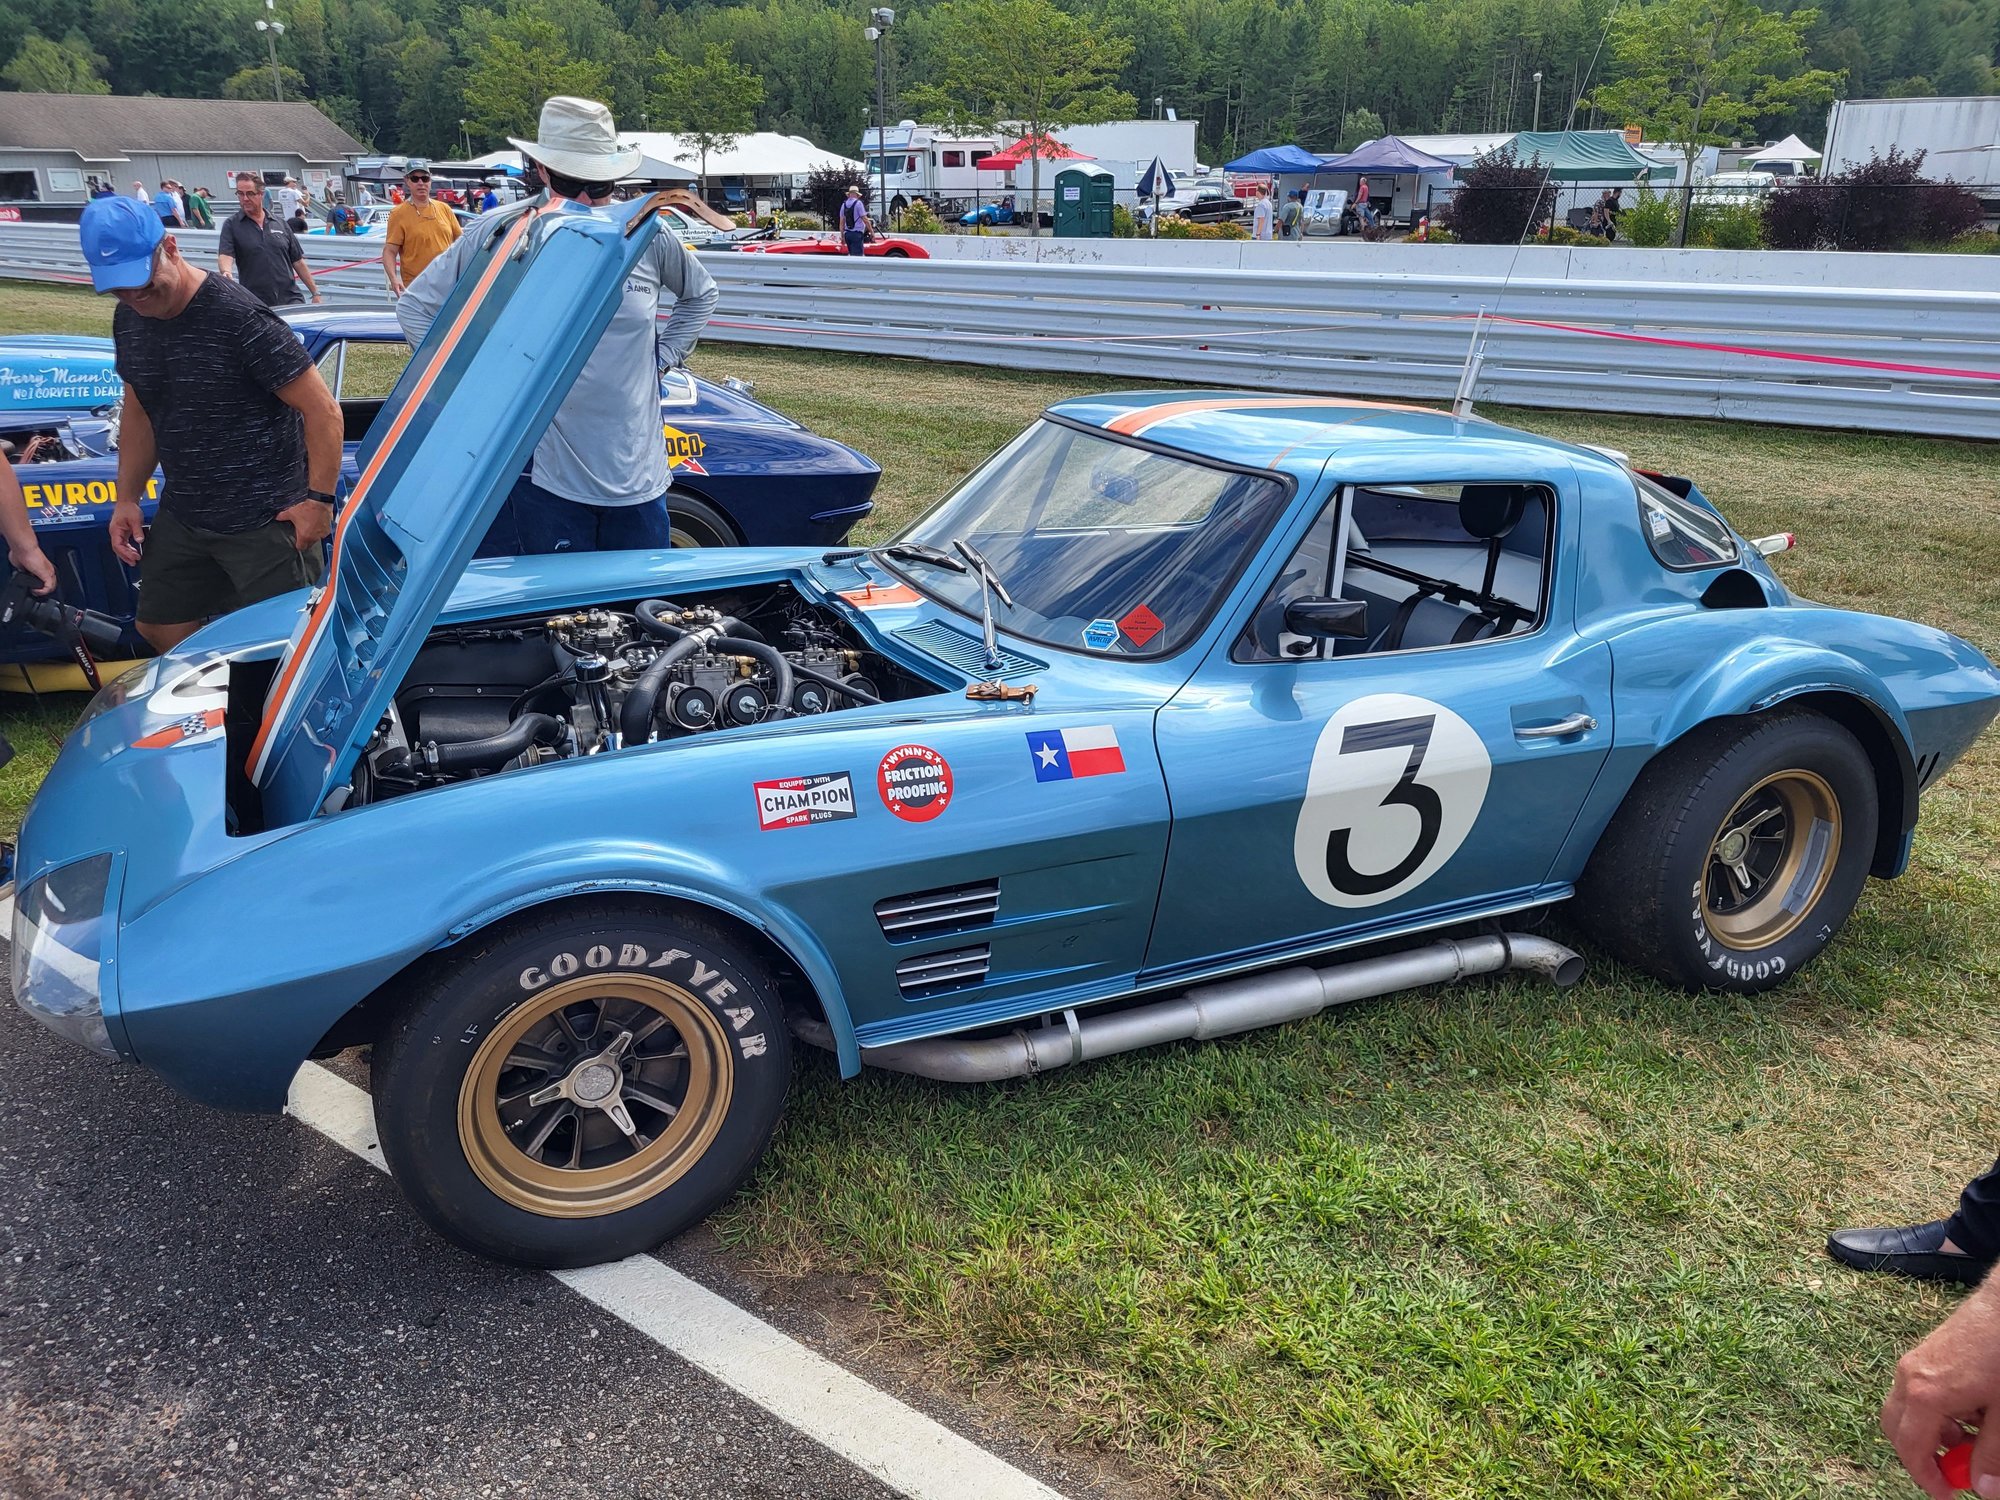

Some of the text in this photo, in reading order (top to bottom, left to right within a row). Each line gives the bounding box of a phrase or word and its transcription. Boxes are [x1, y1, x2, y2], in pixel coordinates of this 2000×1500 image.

[0, 367, 124, 387] Harry Mann CH
[35, 386, 90, 399] CORVETTE
[666, 435, 702, 457] OCO
[75, 646, 94, 676] Canon
[887, 747, 934, 765] WYNN'S
[779, 776, 831, 788] EQUIPPED WITH
[884, 764, 944, 783] FRICTION
[764, 787, 850, 812] CHAMPION
[887, 781, 948, 801] PROOFING
[1326, 714, 1442, 895] 3
[786, 812, 832, 824] SPARK PLUGS
